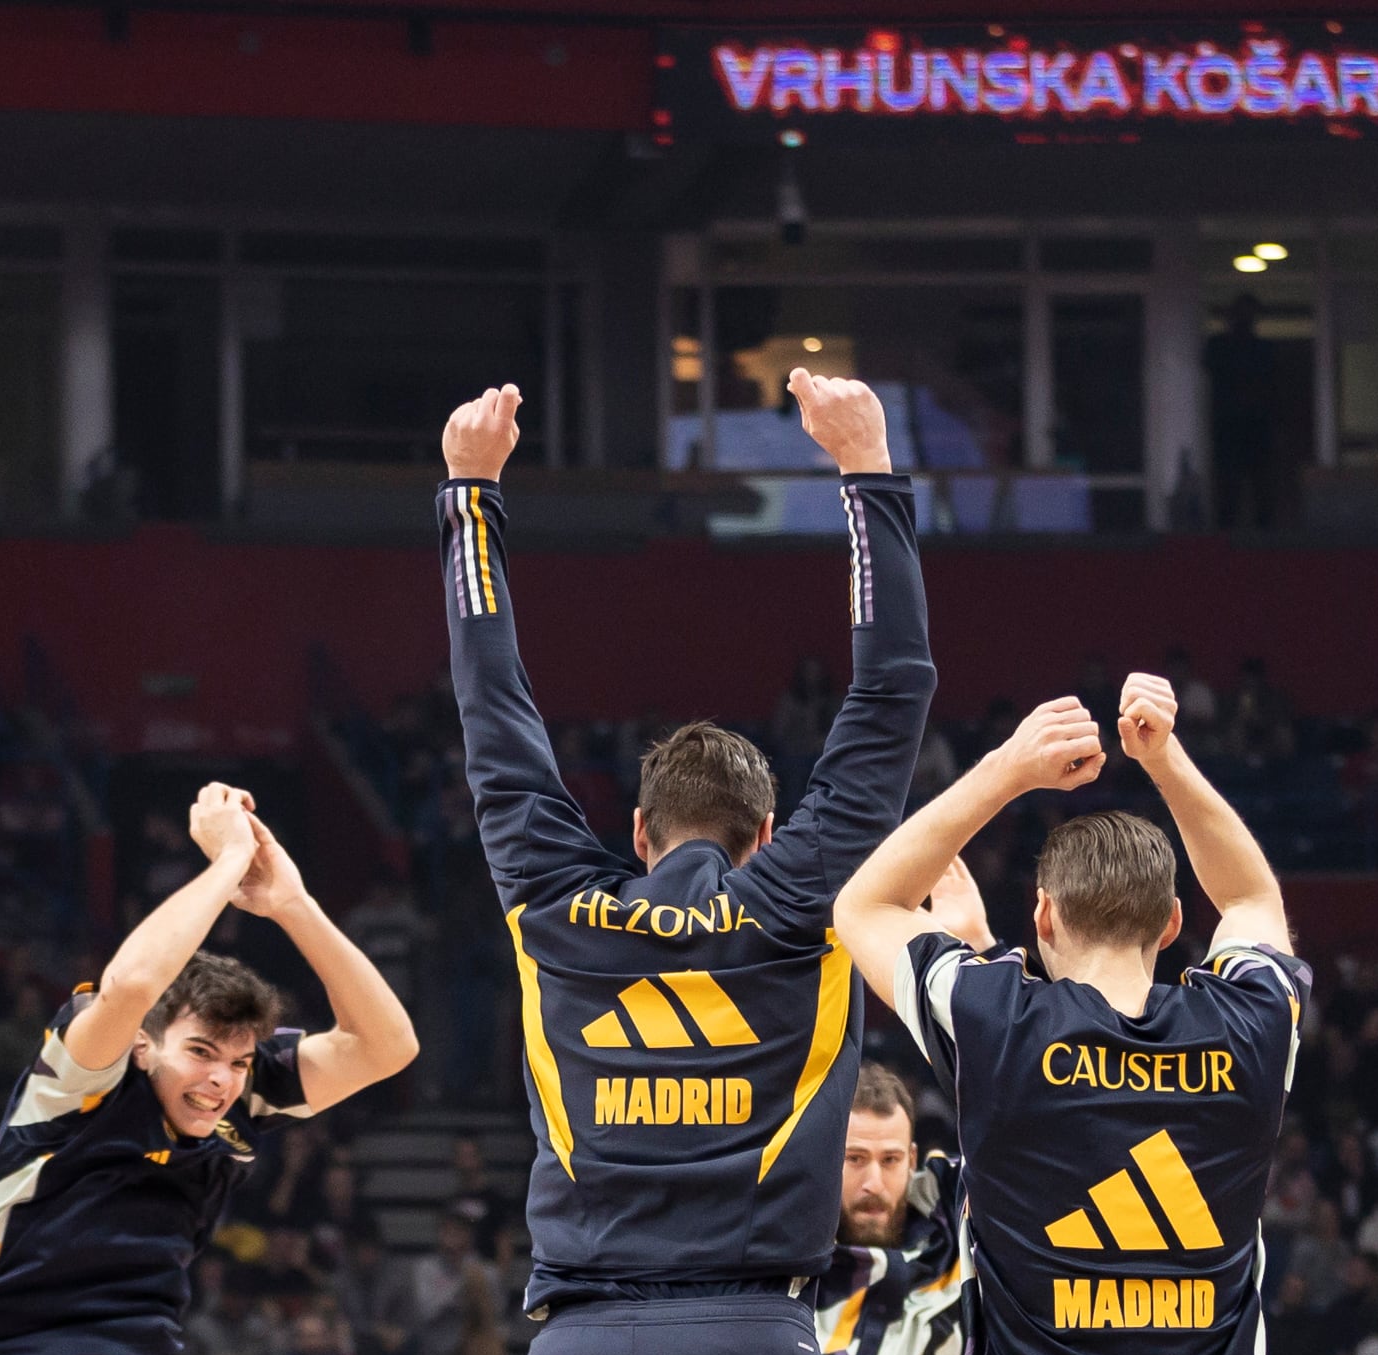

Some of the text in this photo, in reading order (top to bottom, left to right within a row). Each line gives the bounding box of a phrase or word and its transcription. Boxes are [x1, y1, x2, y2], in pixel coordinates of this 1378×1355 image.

[715, 46, 1133, 113] VRHUNSKA
[568, 889, 762, 938] HEZONJA
[1041, 1041, 1236, 1093] CAUSEUR
[594, 1077, 753, 1125] MADRID
[1052, 1278, 1216, 1329] MADRID
